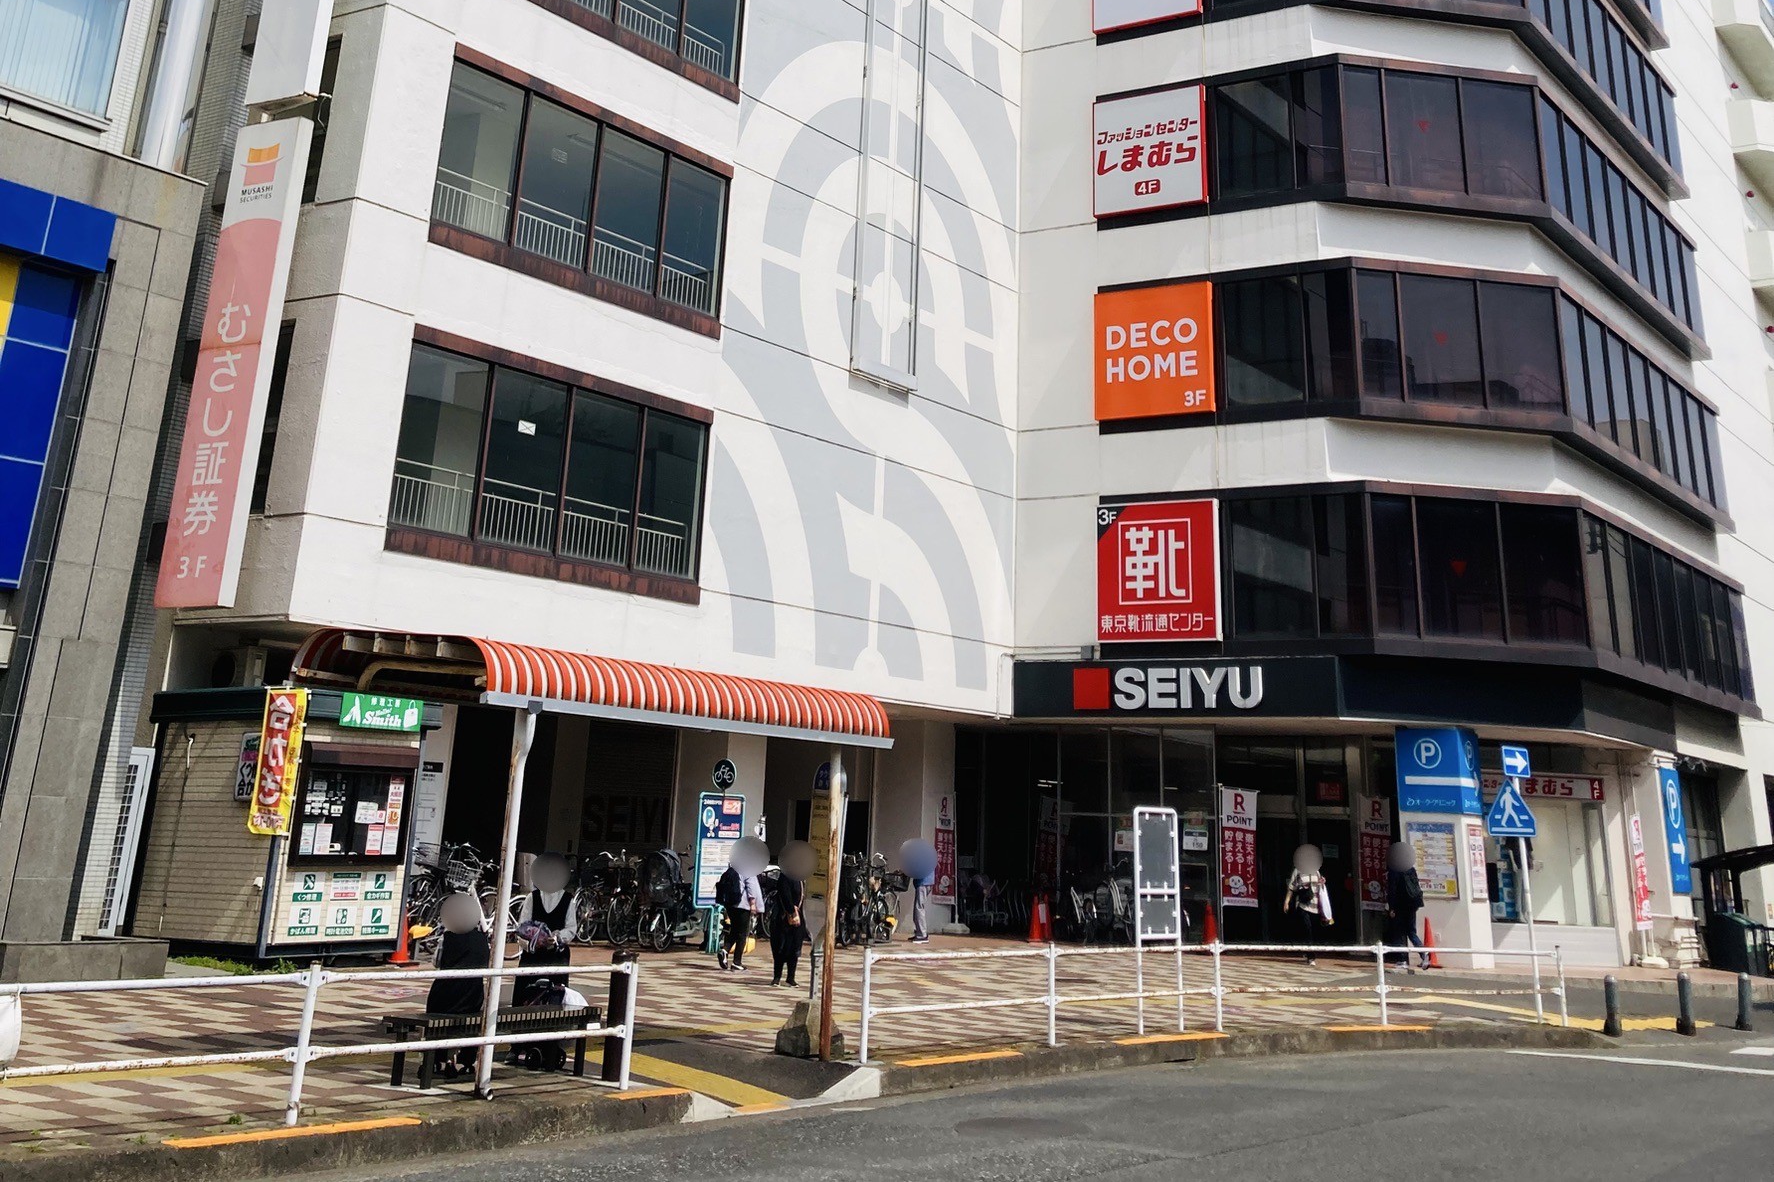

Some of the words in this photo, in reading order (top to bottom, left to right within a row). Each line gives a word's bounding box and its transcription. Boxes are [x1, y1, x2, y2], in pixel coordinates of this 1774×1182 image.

[1097, 118, 1198, 145] ファッションセンター
[1097, 135, 1198, 176] しまむら
[241, 185, 273, 196] MUSASHI
[1137, 180, 1158, 195] 4F
[1106, 318, 1198, 351] DECO
[1106, 350, 1198, 384] HOME
[1184, 389, 1206, 407] 3F
[183, 301, 251, 537] むさし証券
[1098, 508, 1117, 525] 3F
[176, 554, 207, 579] 3F
[1125, 526, 1186, 598] 靴
[1101, 613, 1214, 634] 東京靴流通センター
[1114, 666, 1263, 709] SEIYU
[362, 711, 402, 727] Smith
[1421, 743, 1435, 764] P
[1524, 779, 1574, 796] まむら
[1233, 793, 1245, 811] R
[1226, 815, 1252, 827] POINT
[1245, 832, 1255, 895] 楽天ポイント
